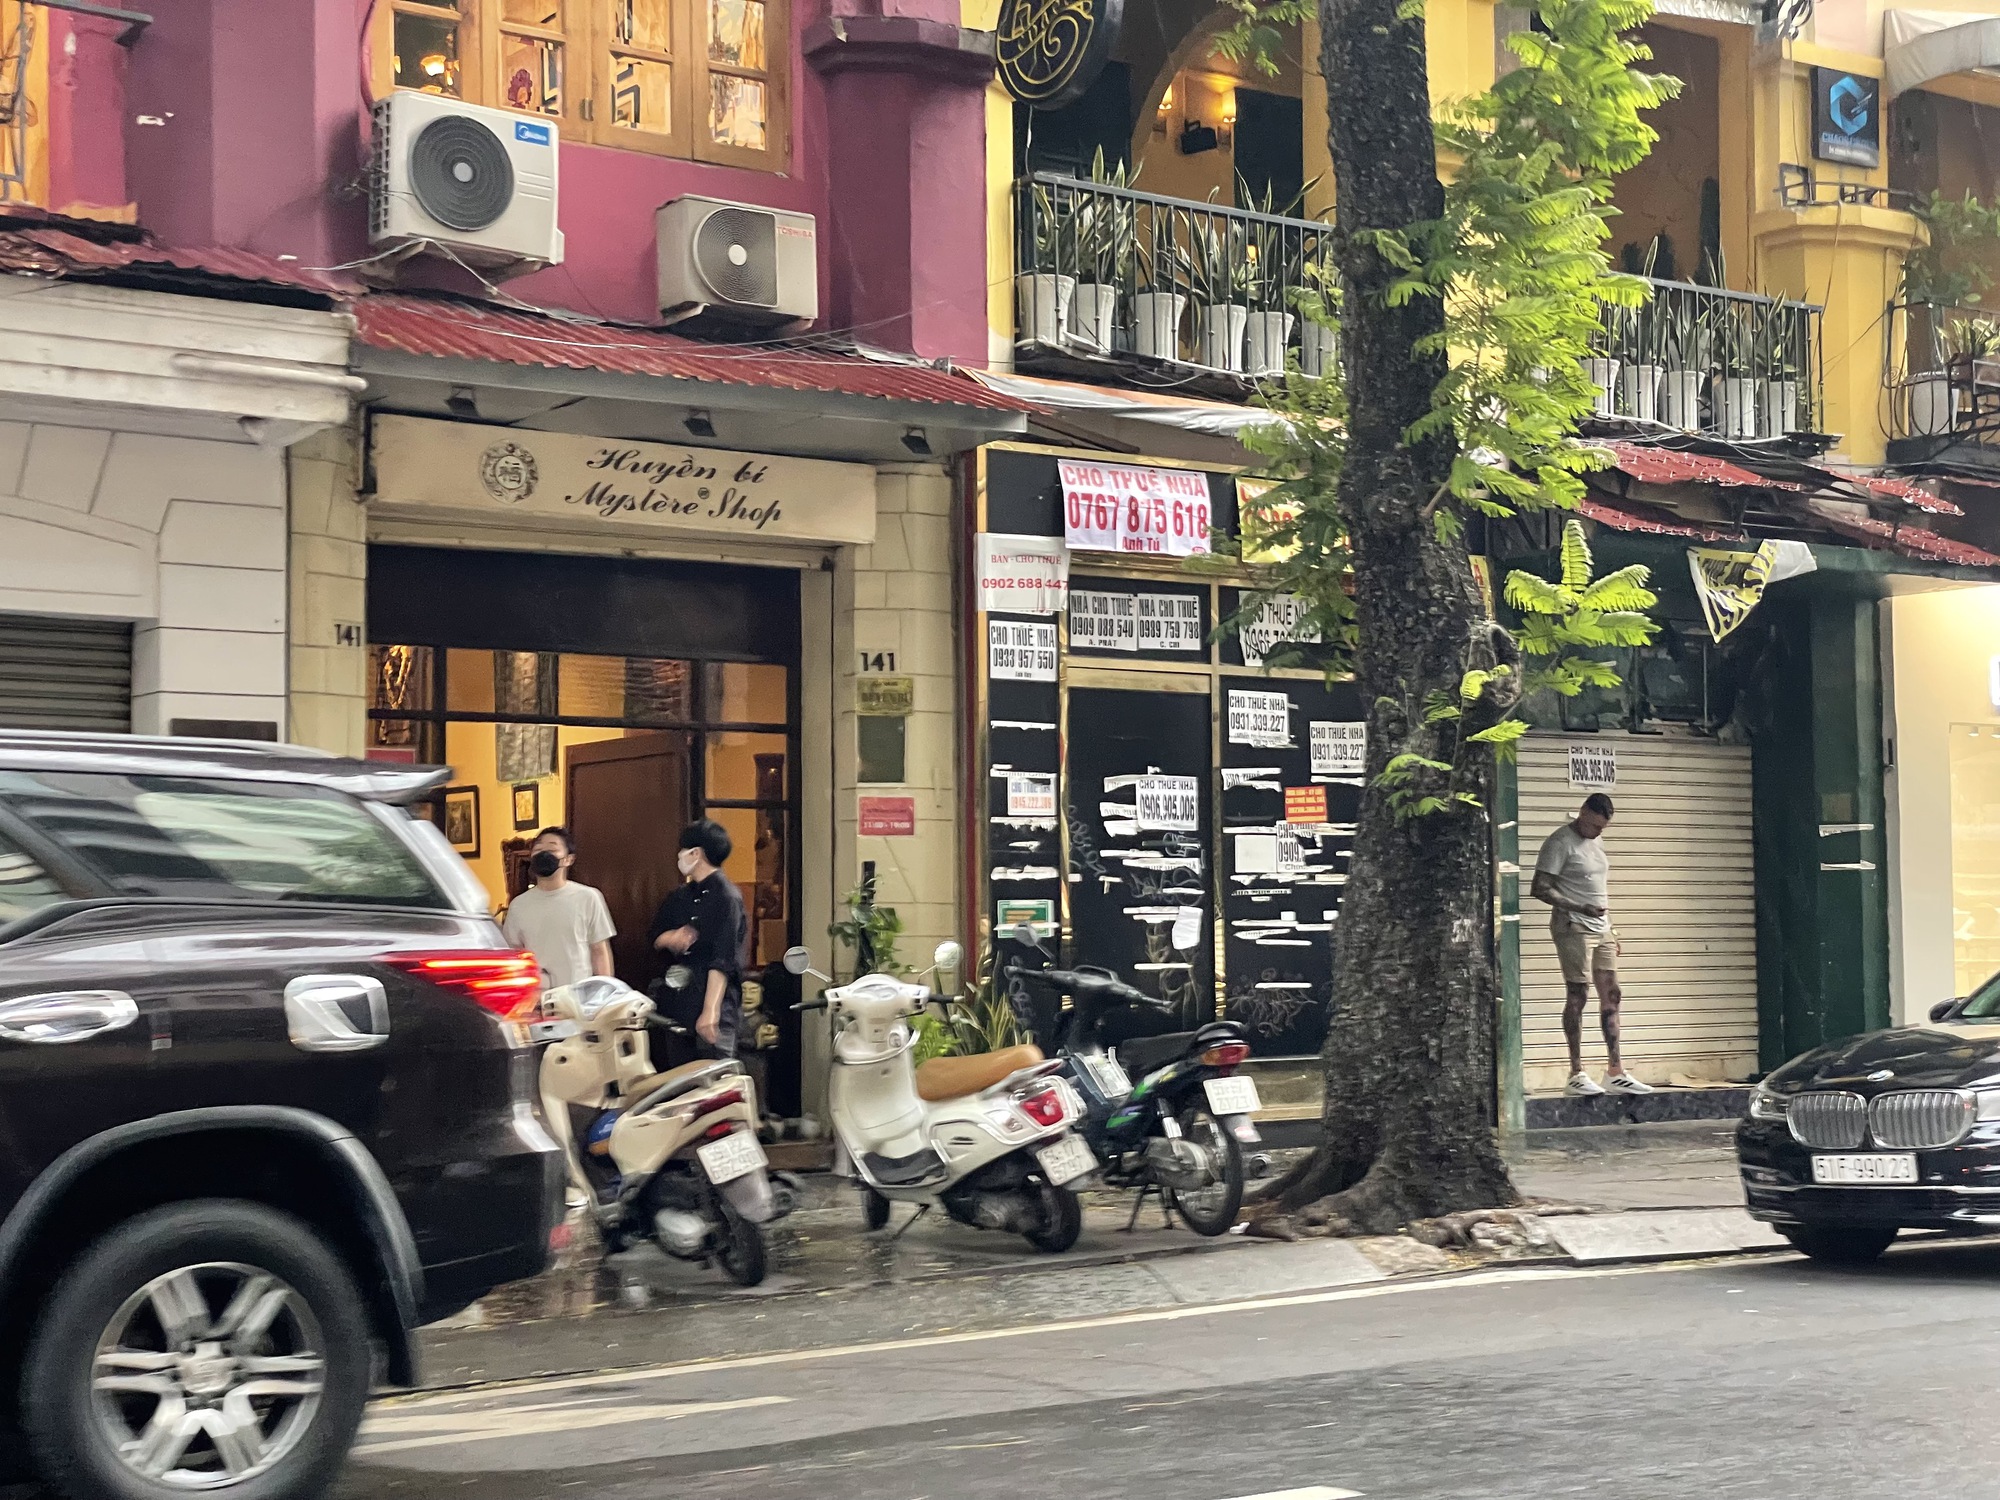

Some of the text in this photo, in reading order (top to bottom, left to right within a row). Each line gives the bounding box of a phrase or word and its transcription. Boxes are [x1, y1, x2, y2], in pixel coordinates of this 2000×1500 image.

[586, 449, 768, 485] Huyền bí
[1063, 466, 1206, 497] CHO THUÊ NHÀ
[708, 488, 782, 530] Shop
[1068, 492, 1120, 530] 0767
[1127, 496, 1167, 534] 875
[1173, 500, 1208, 539] 618
[1123, 536, 1143, 550] Anh
[1016, 555, 1034, 563] CHO
[982, 578, 1014, 589] 0902
[1017, 578, 1042, 589] 688
[1092, 596, 1108, 615] CHO
[1159, 600, 1174, 617] CHO
[334, 624, 360, 647] 141
[990, 626, 1008, 645] CHO
[1072, 617, 1133, 638] 0909 088 540
[1140, 620, 1199, 639] 0989 759 798
[861, 652, 895, 671] 141
[993, 648, 1054, 670] 0933 957 550
[1229, 696, 1245, 708] CHO
[1230, 712, 1285, 732] 0931.339.227
[1310, 727, 1326, 738] CHO
[1312, 743, 1364, 760] 0931.339.227
[1139, 780, 1155, 789] CHO
[1139, 794, 1195, 820] 0906.905.006
